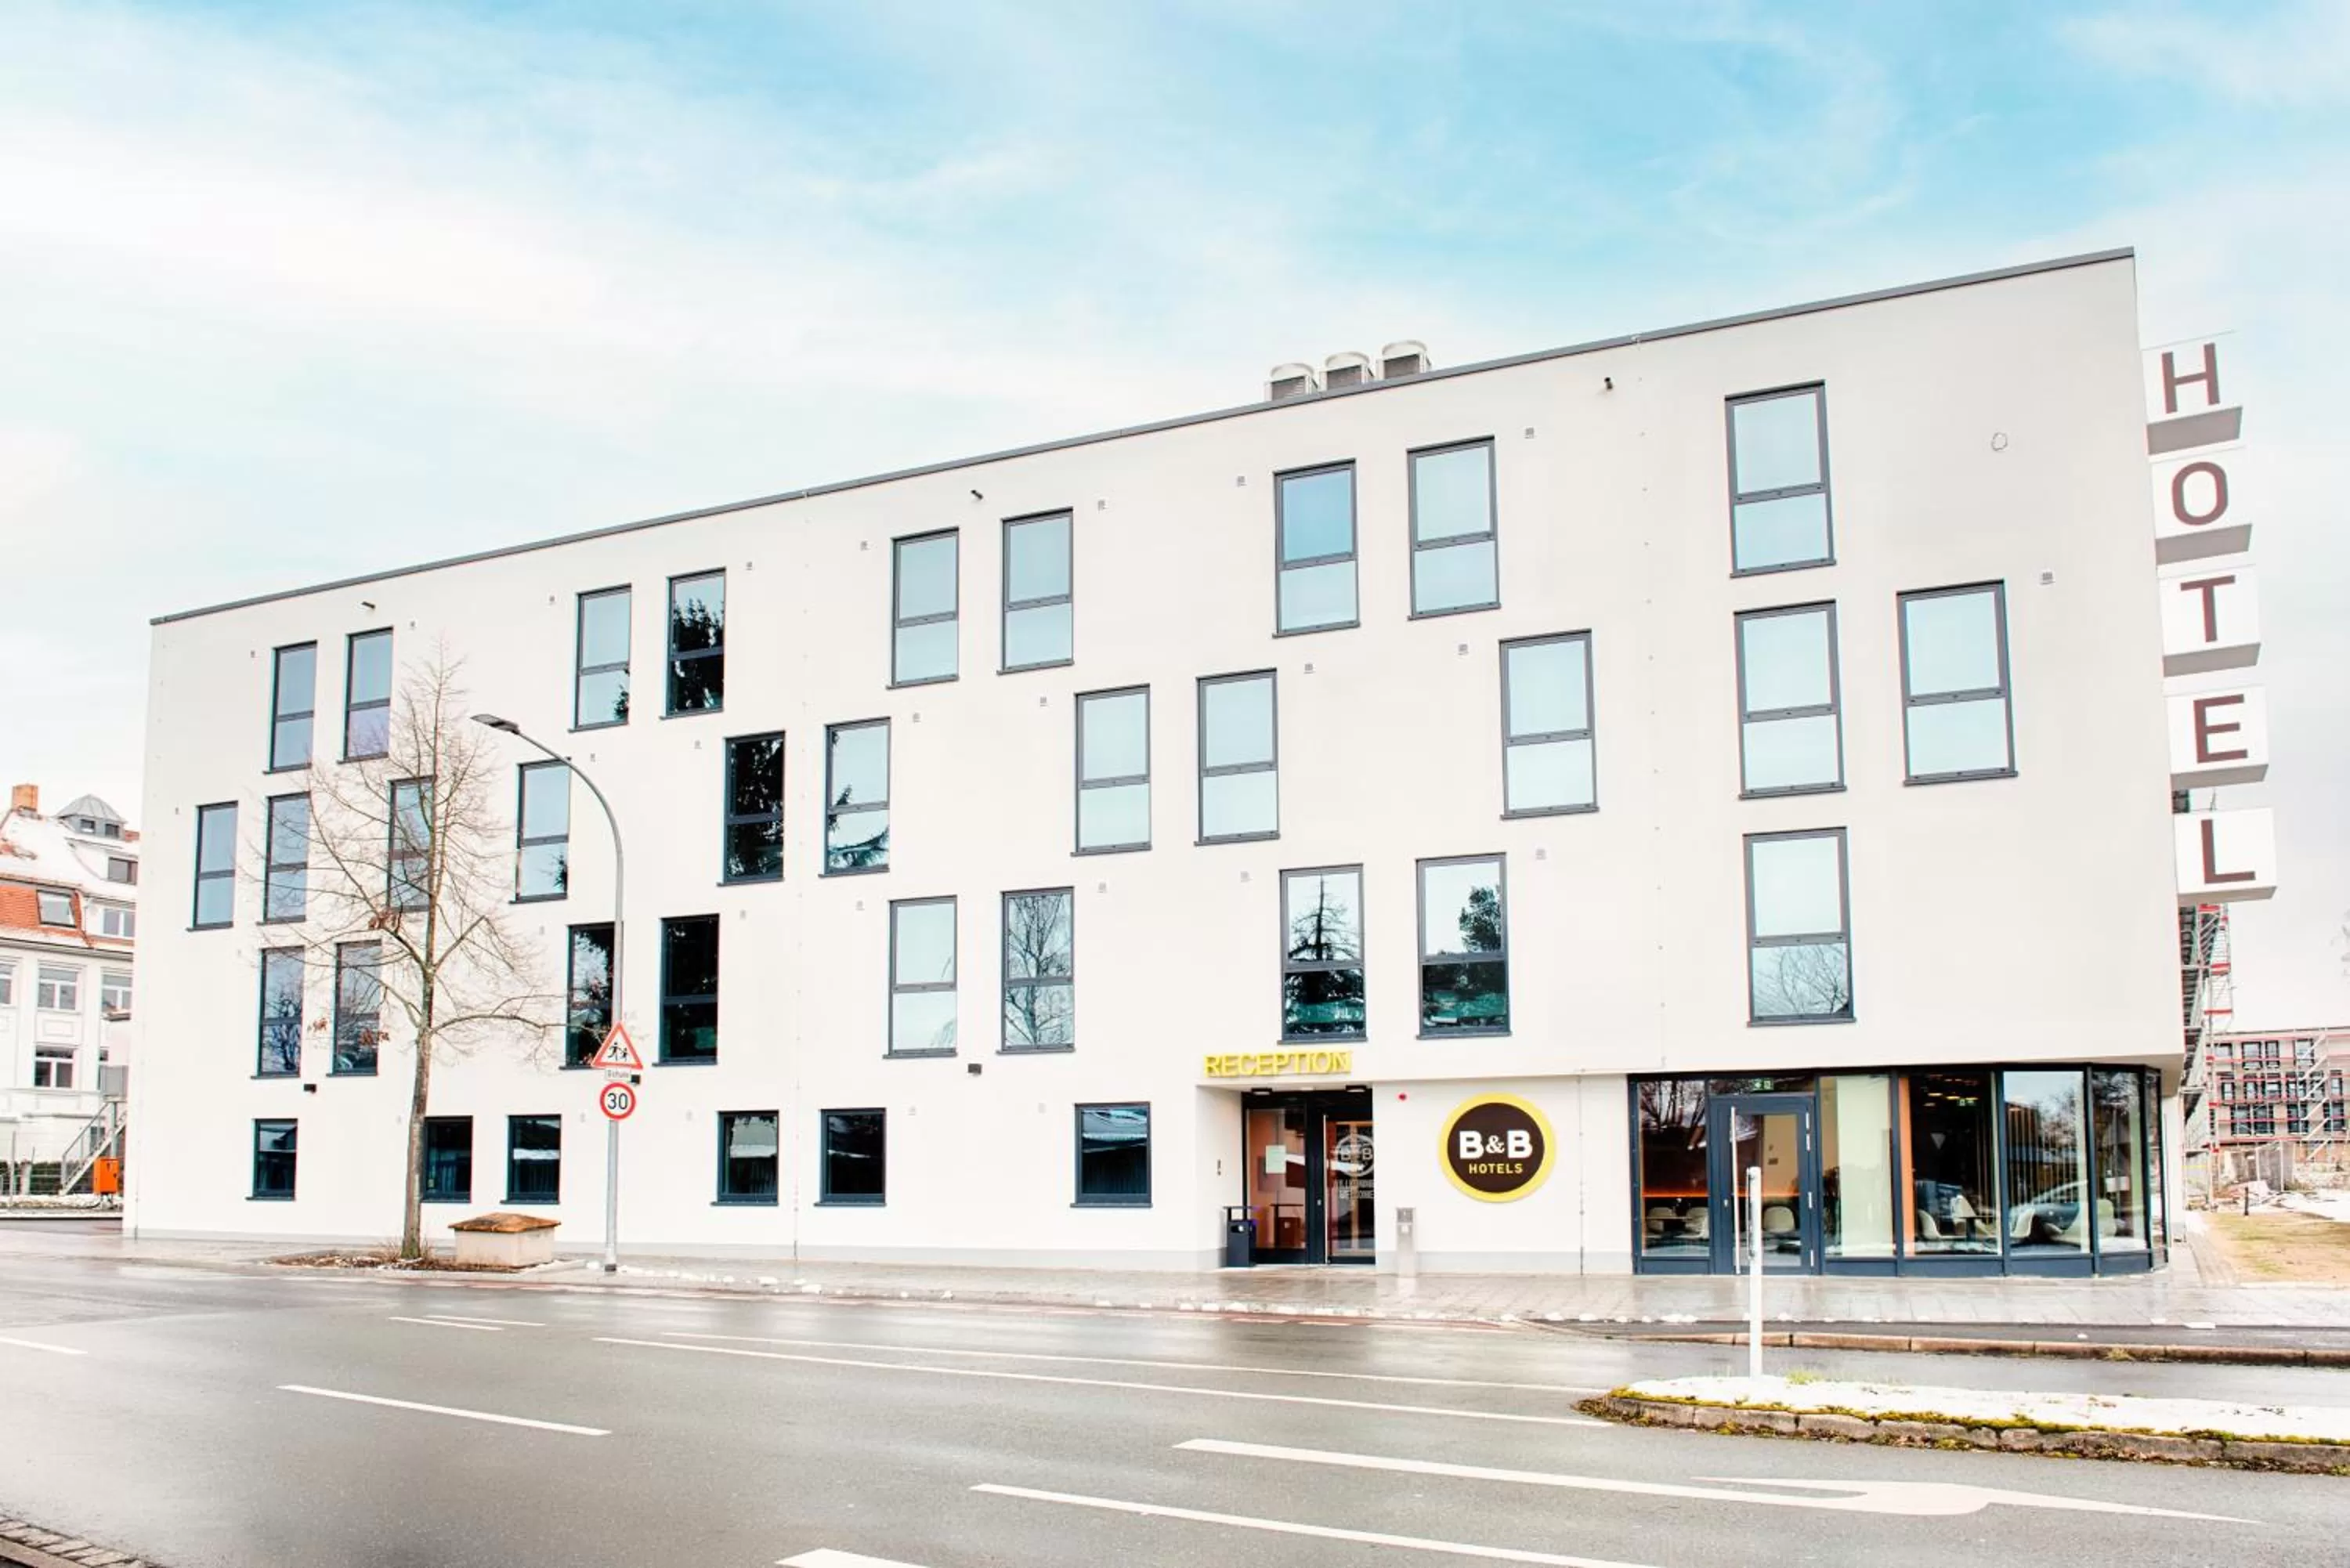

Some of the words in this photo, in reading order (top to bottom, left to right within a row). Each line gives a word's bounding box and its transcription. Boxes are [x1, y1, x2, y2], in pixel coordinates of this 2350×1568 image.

[2161, 342, 2256, 884] HOTEL
[1204, 1051, 1352, 1078] RECEPTION
[607, 1093, 628, 1109] 30
[1459, 1130, 1533, 1159] B&B
[1469, 1163, 1524, 1174] HOTELS
